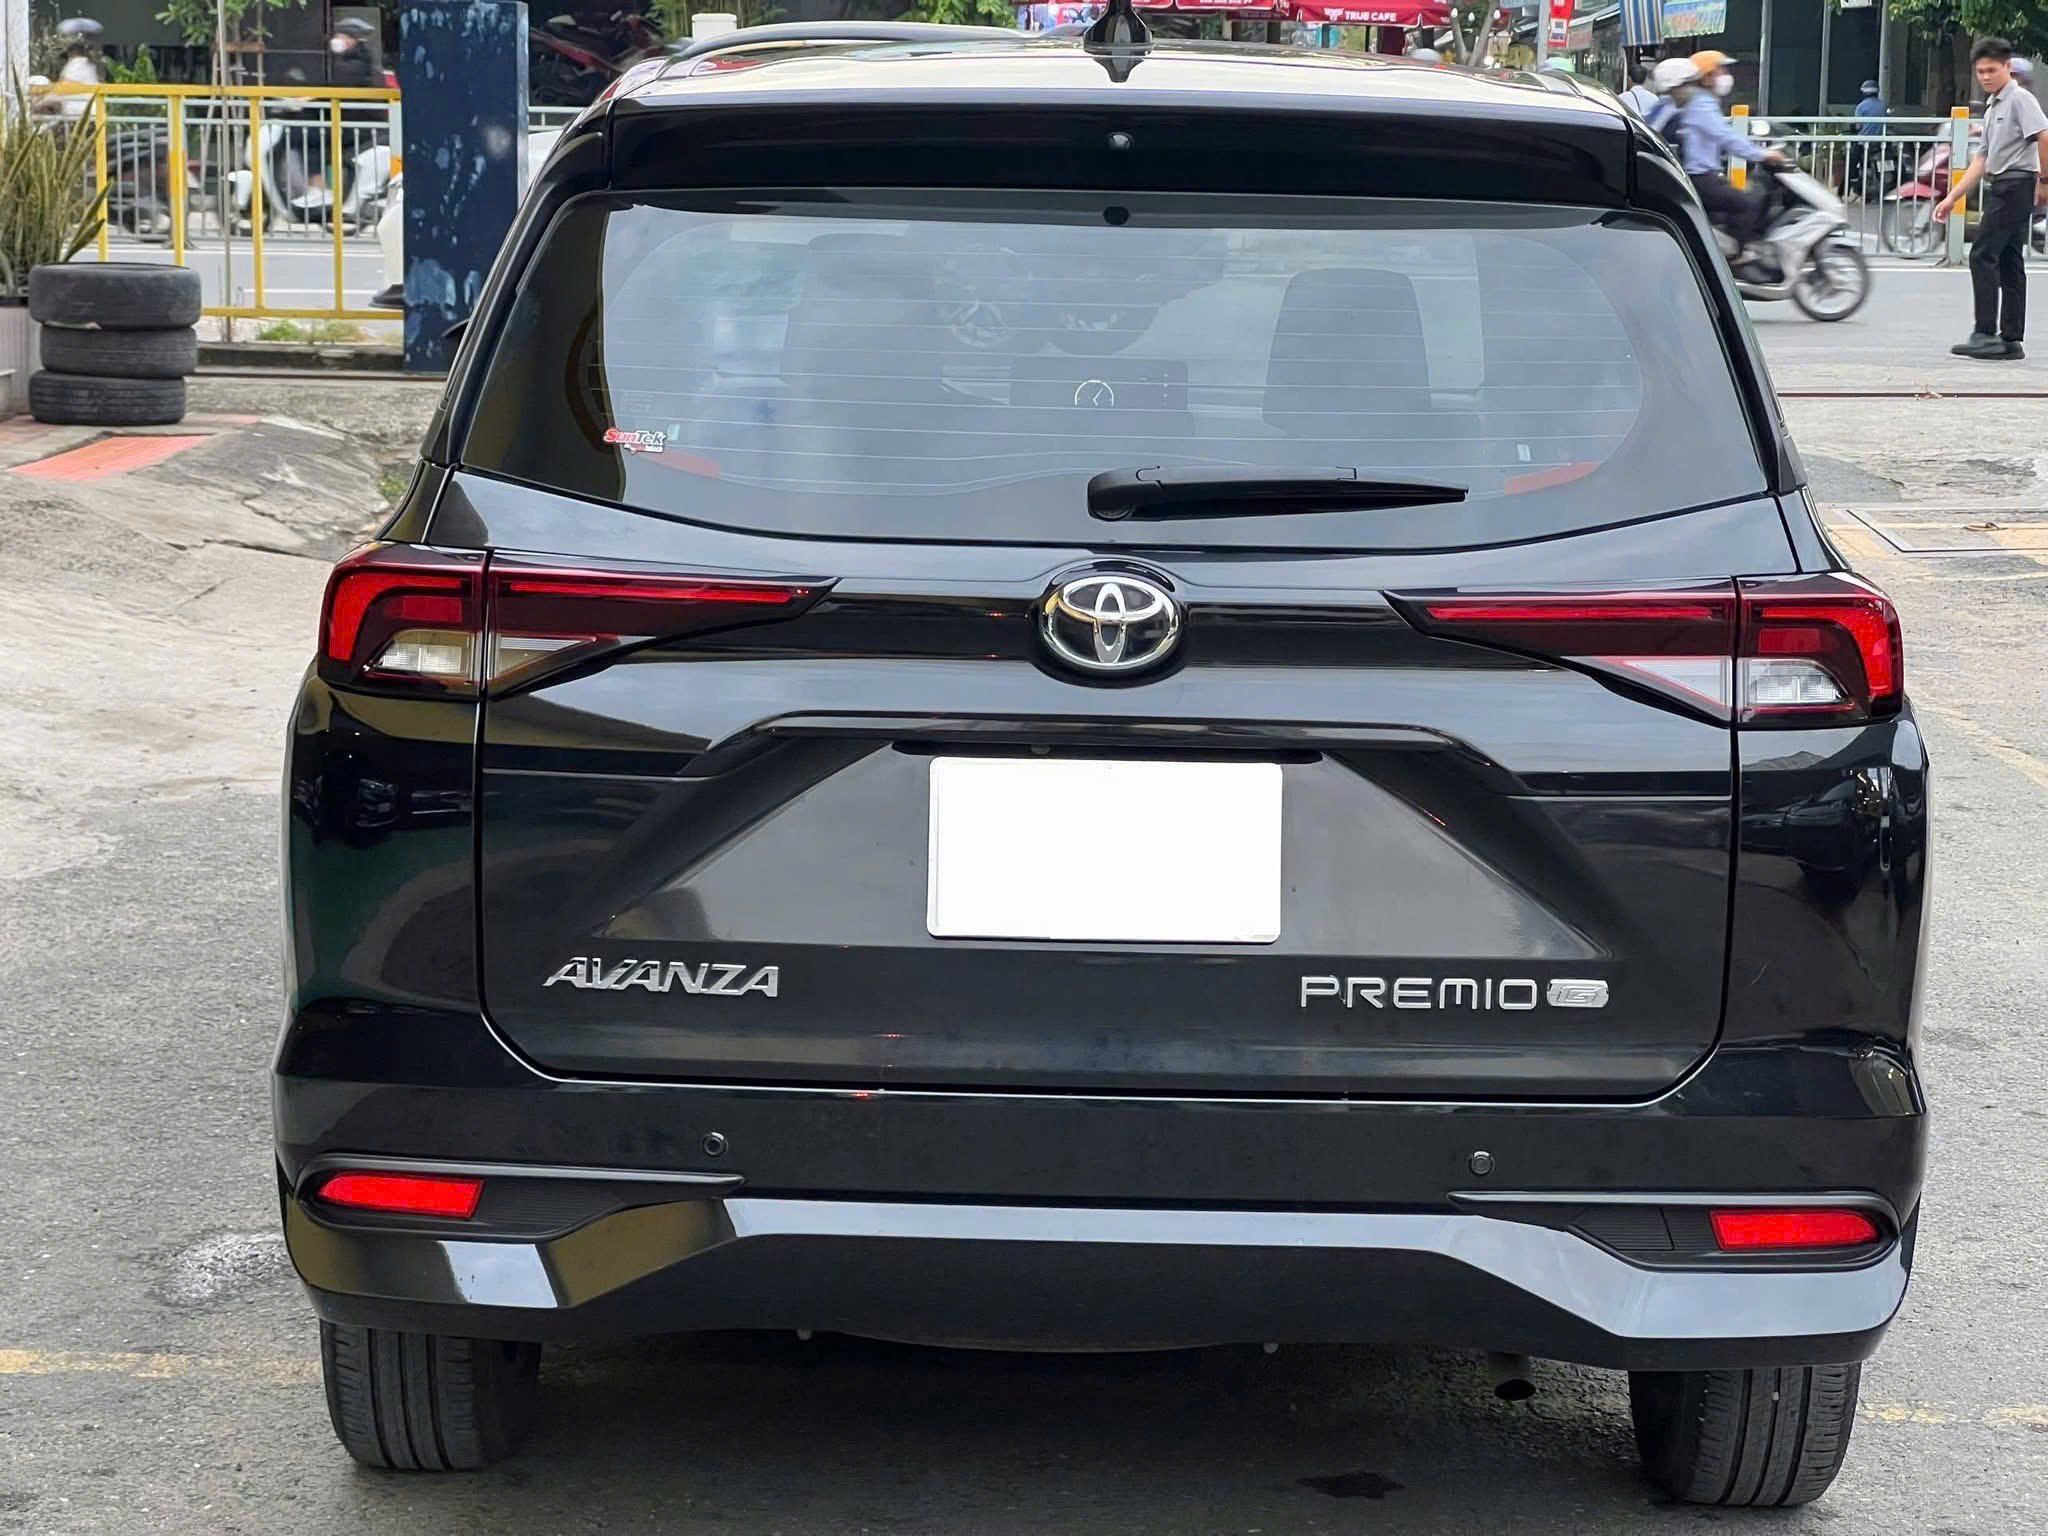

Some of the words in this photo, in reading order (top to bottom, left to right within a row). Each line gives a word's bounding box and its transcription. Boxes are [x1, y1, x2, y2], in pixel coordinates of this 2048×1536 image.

[1344, 11, 1370, 21] TRUE
[1371, 12, 1397, 22] CAFE
[603, 427, 667, 446] SunTek
[542, 956, 780, 998] AVANZA
[1300, 976, 1538, 1011] PREMIO
[1550, 981, 1605, 1006] G
